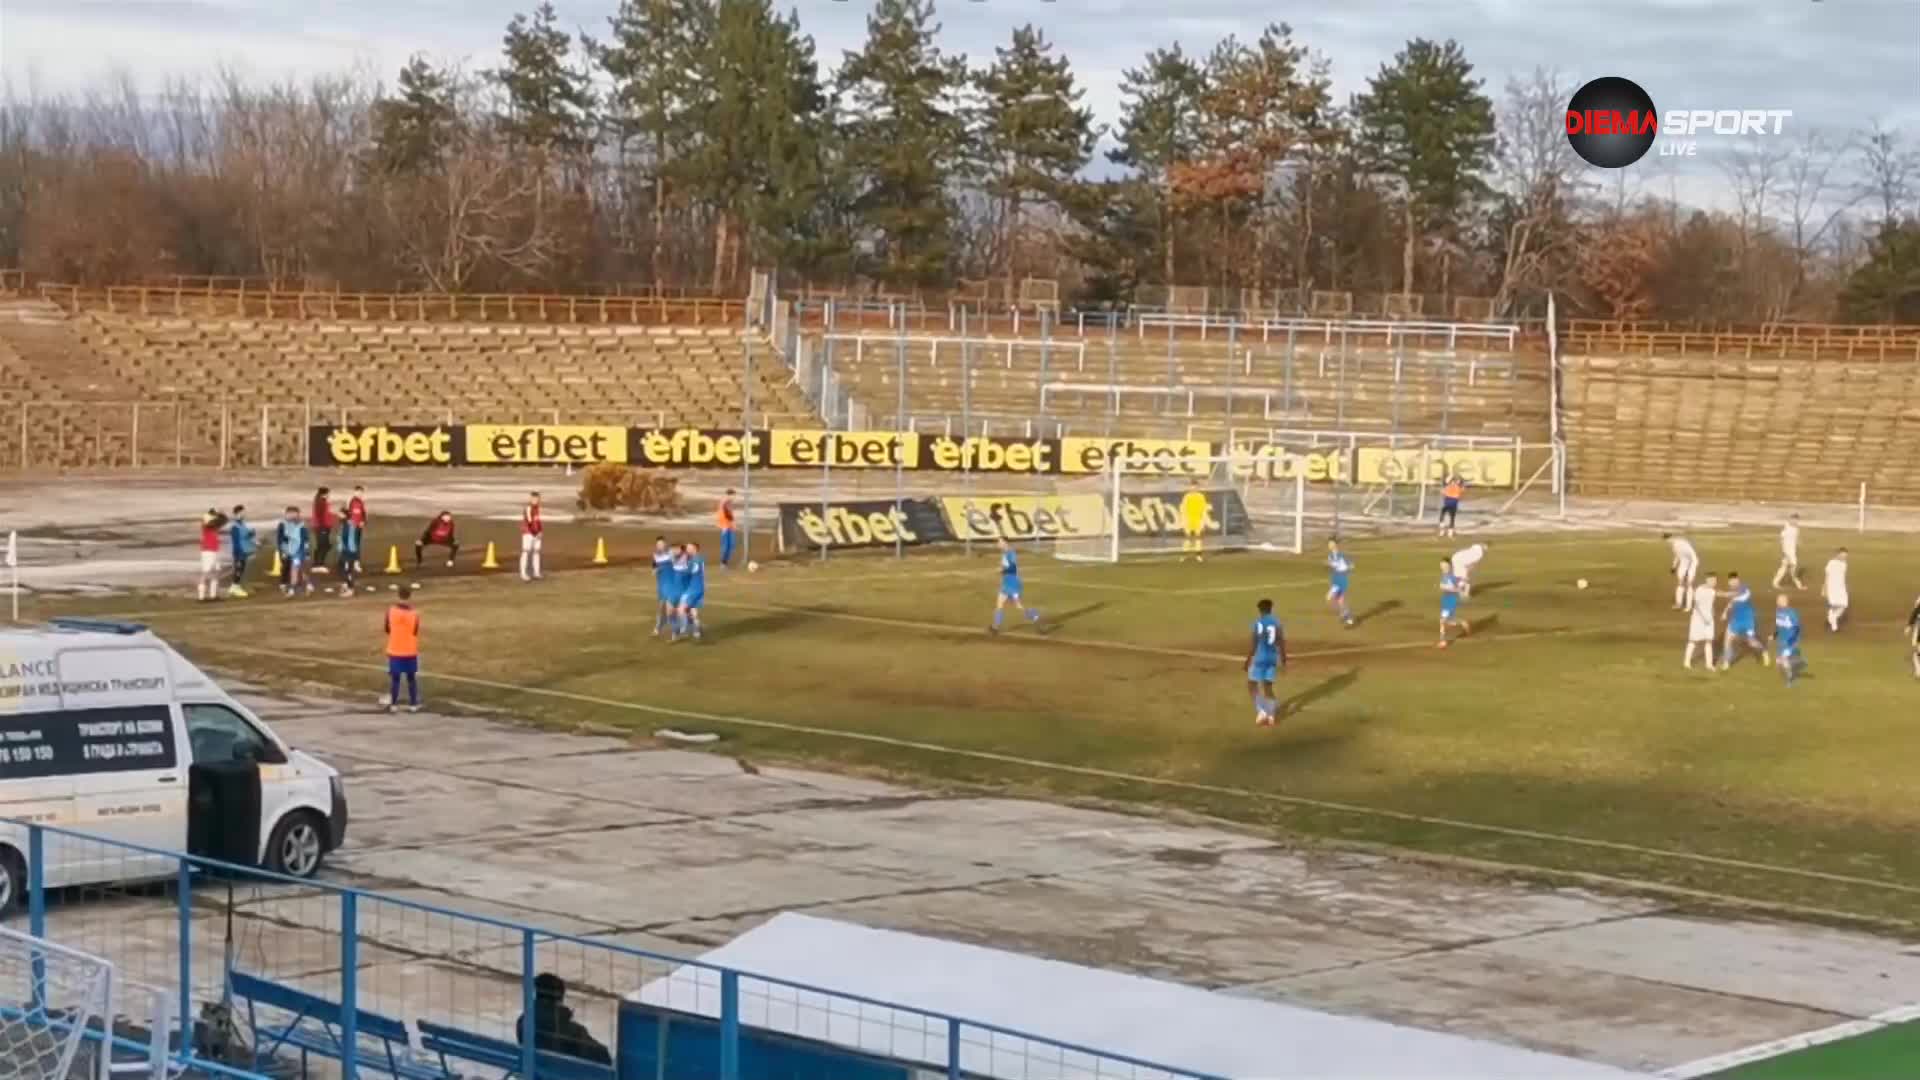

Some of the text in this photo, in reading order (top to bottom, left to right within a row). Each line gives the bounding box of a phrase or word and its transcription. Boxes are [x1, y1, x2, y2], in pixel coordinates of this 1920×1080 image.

[328, 427, 451, 462] efbet
[490, 428, 608, 461] efbet
[642, 430, 760, 464] efbet
[789, 434, 903, 465] efbet
[932, 437, 1051, 470] efbet
[1080, 441, 1198, 473] efbet
[798, 505, 916, 545] efbet
[962, 502, 1080, 536] efbet
